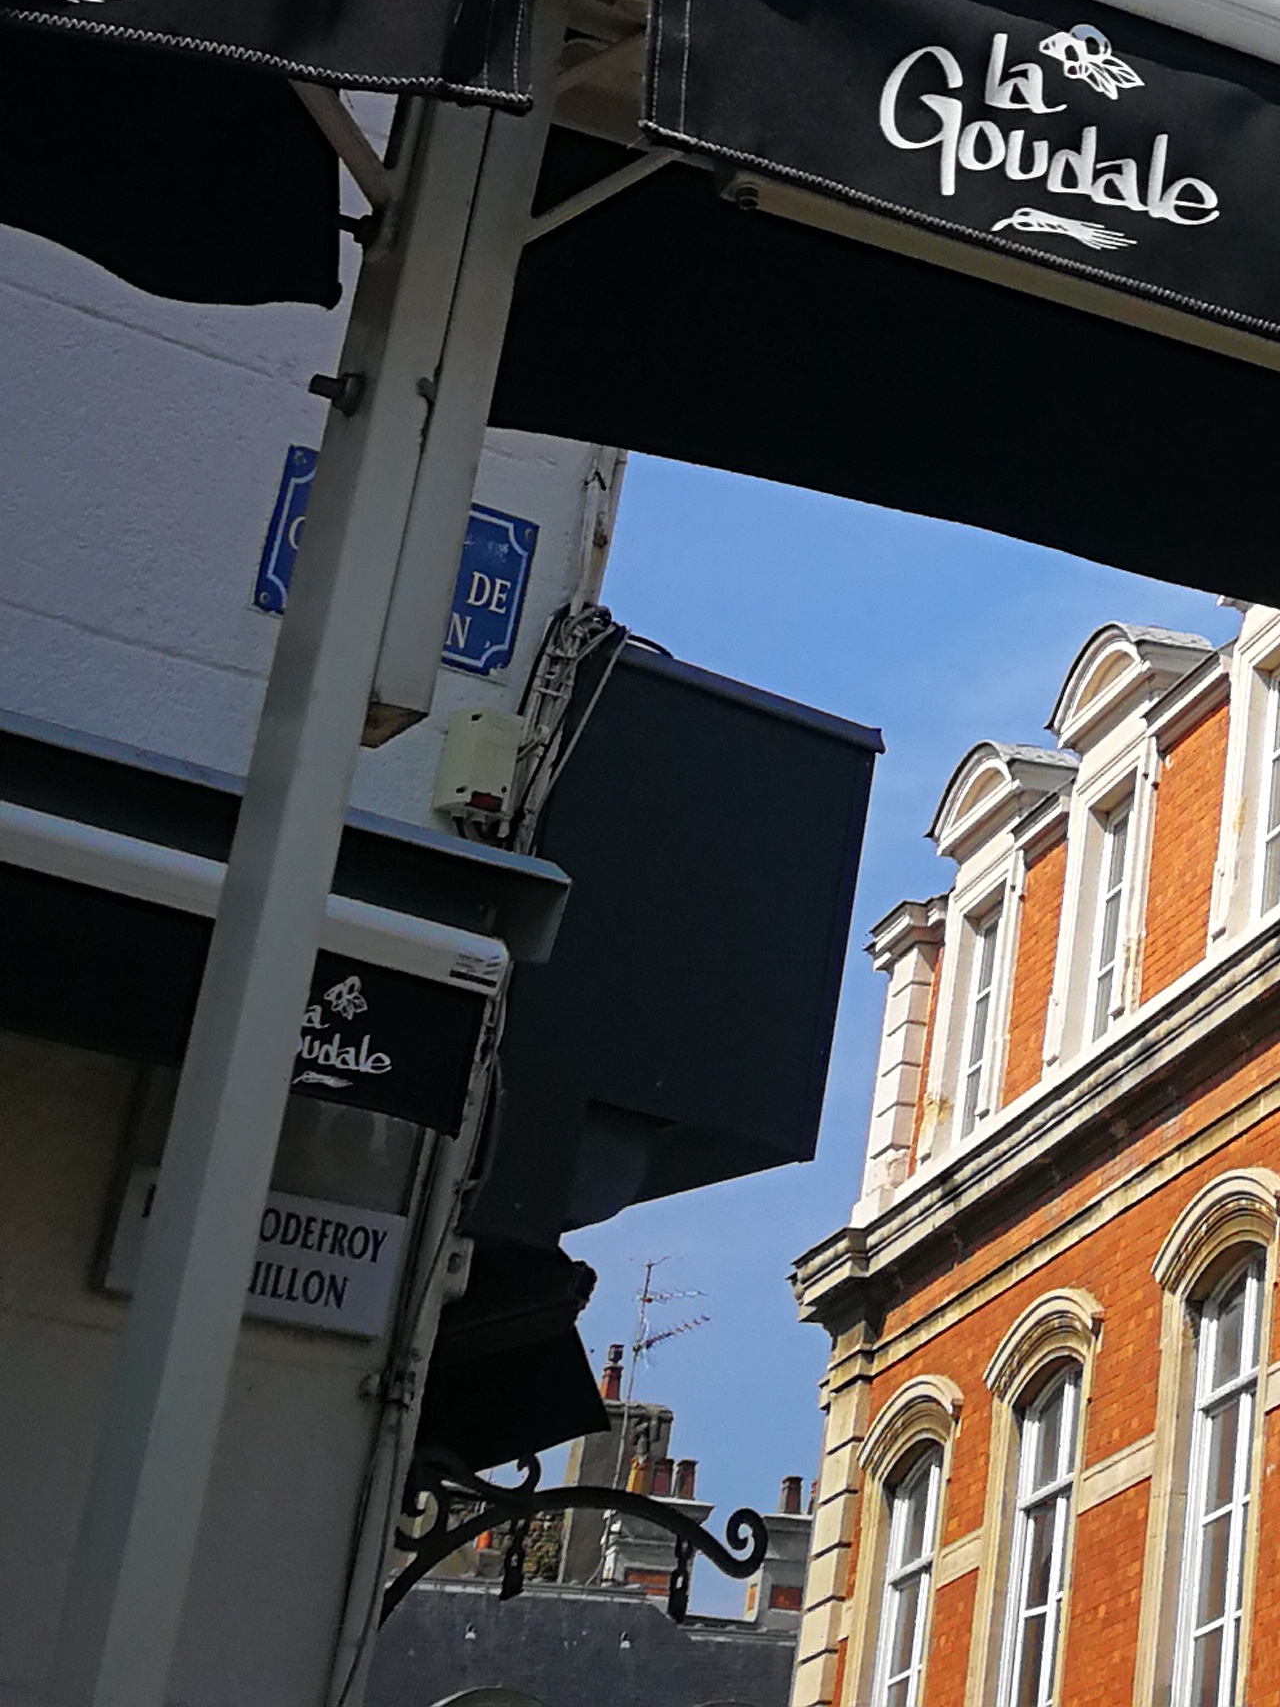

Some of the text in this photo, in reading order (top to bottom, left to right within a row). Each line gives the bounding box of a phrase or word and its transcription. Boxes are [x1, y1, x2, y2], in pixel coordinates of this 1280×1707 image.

[984, 33, 1068, 114] la
[878, 44, 1221, 227] Goudale
[466, 570, 512, 615] DE
[301, 1004, 330, 1029] a
[297, 1033, 392, 1074] udale
[260, 1207, 388, 1263] ODEFROY
[248, 1260, 350, 1309] ILLON
